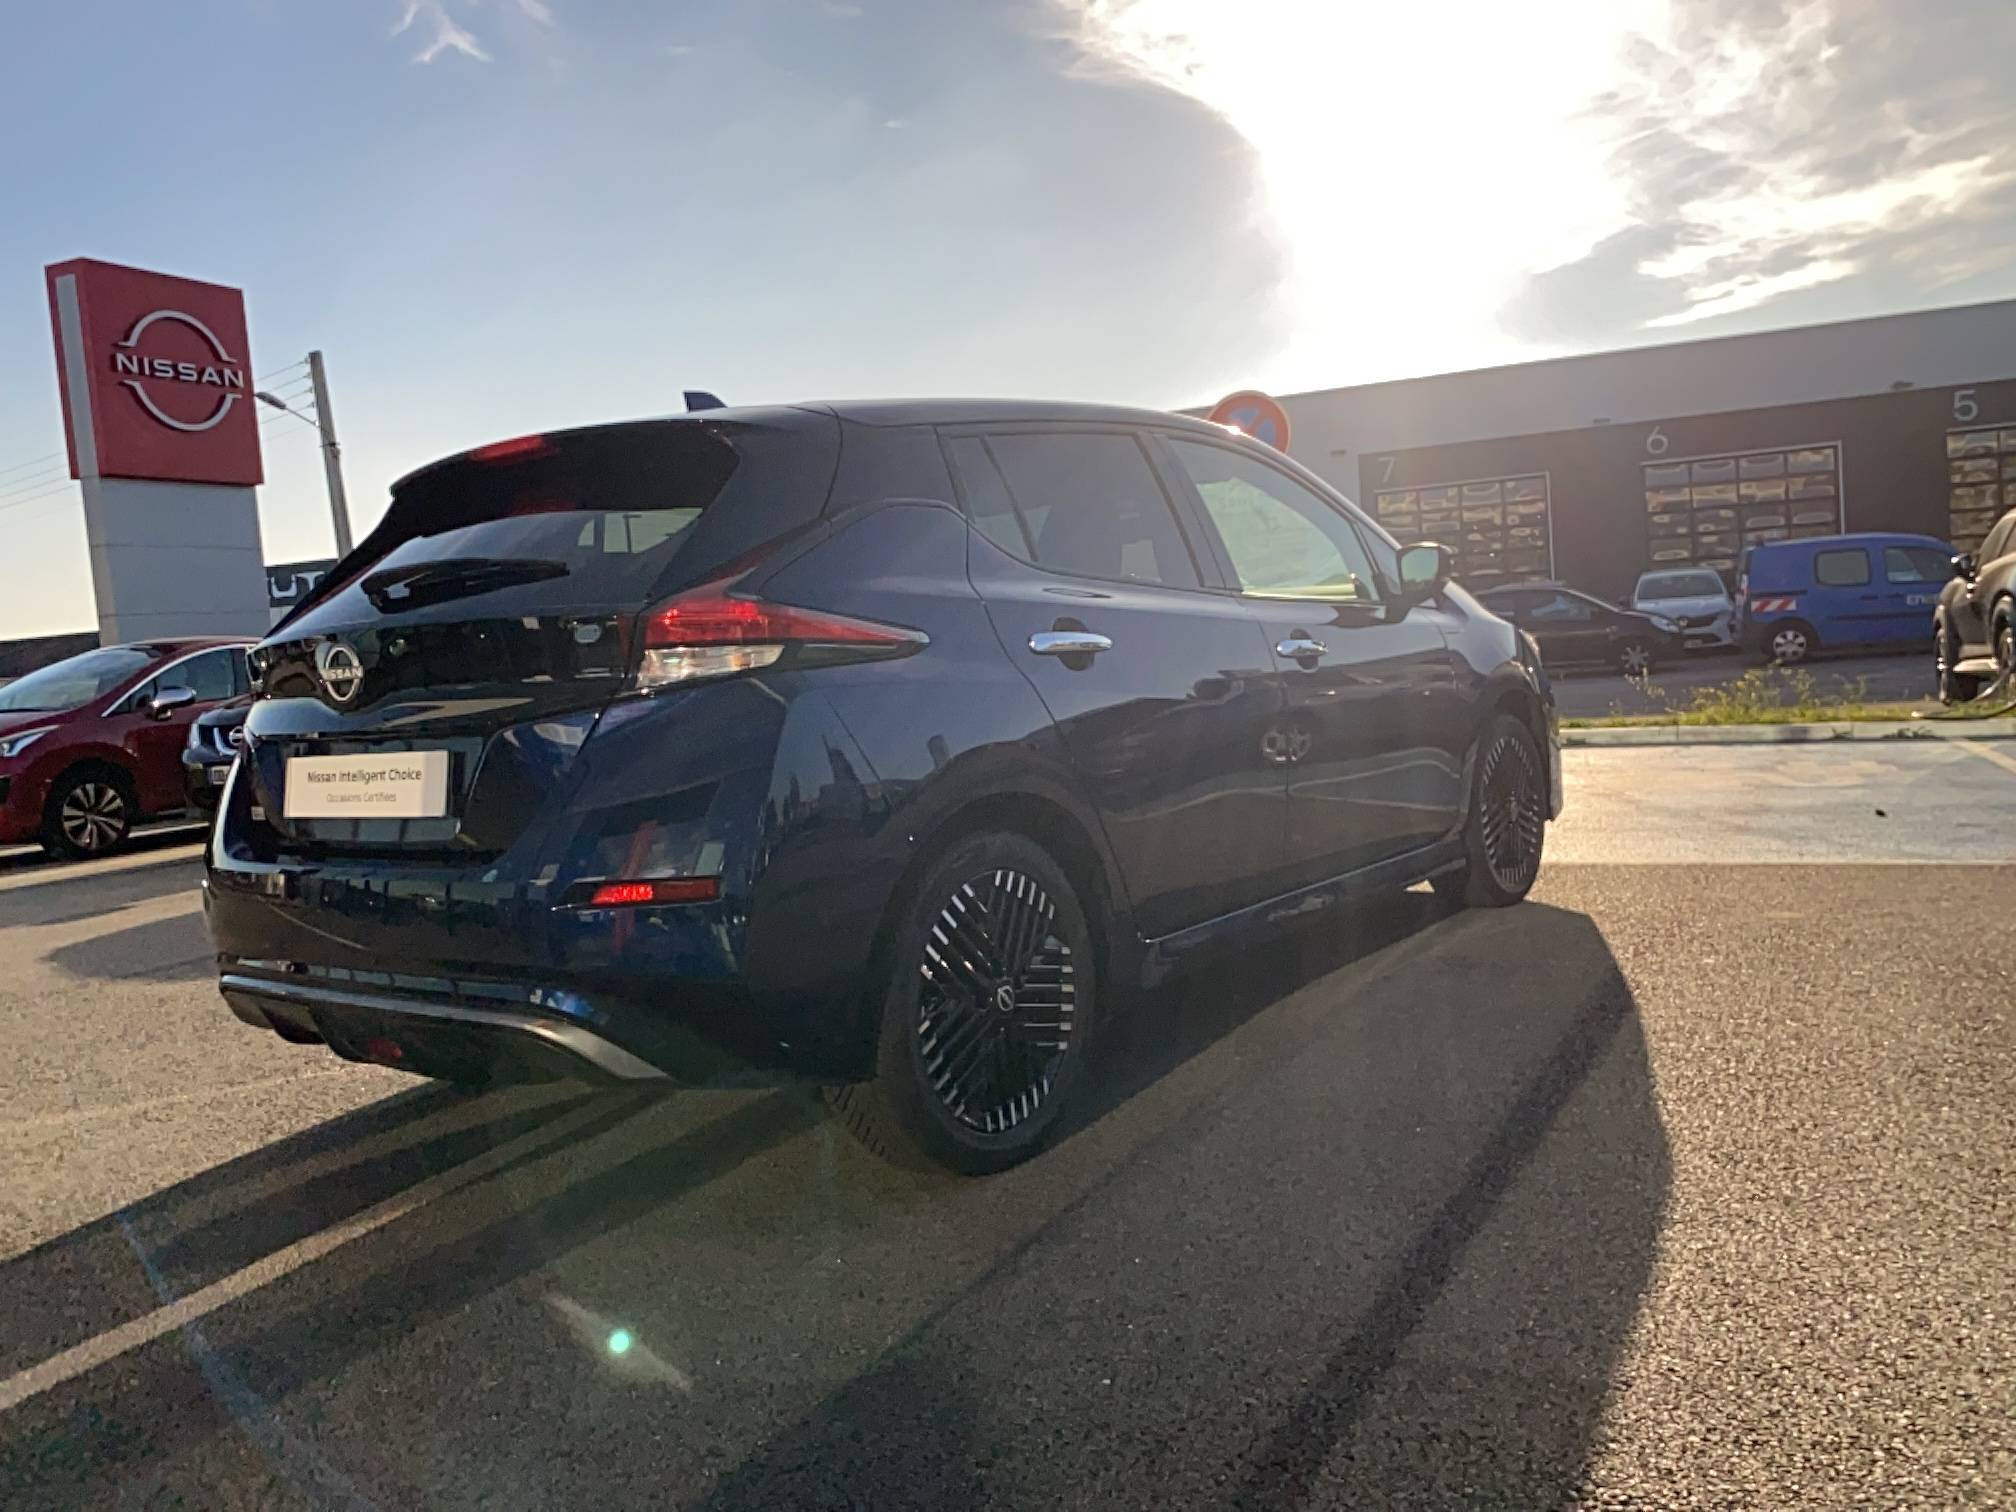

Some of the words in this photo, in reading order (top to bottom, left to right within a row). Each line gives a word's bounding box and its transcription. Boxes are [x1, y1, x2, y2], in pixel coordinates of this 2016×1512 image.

[115, 352, 244, 388] NISSAN
[1953, 389, 1978, 421] 5
[1646, 425, 1669, 454] 6
[1377, 456, 1396, 483] 7
[307, 771, 337, 783] Nissan
[338, 769, 386, 785] Intelligent
[388, 767, 422, 781] Choice
